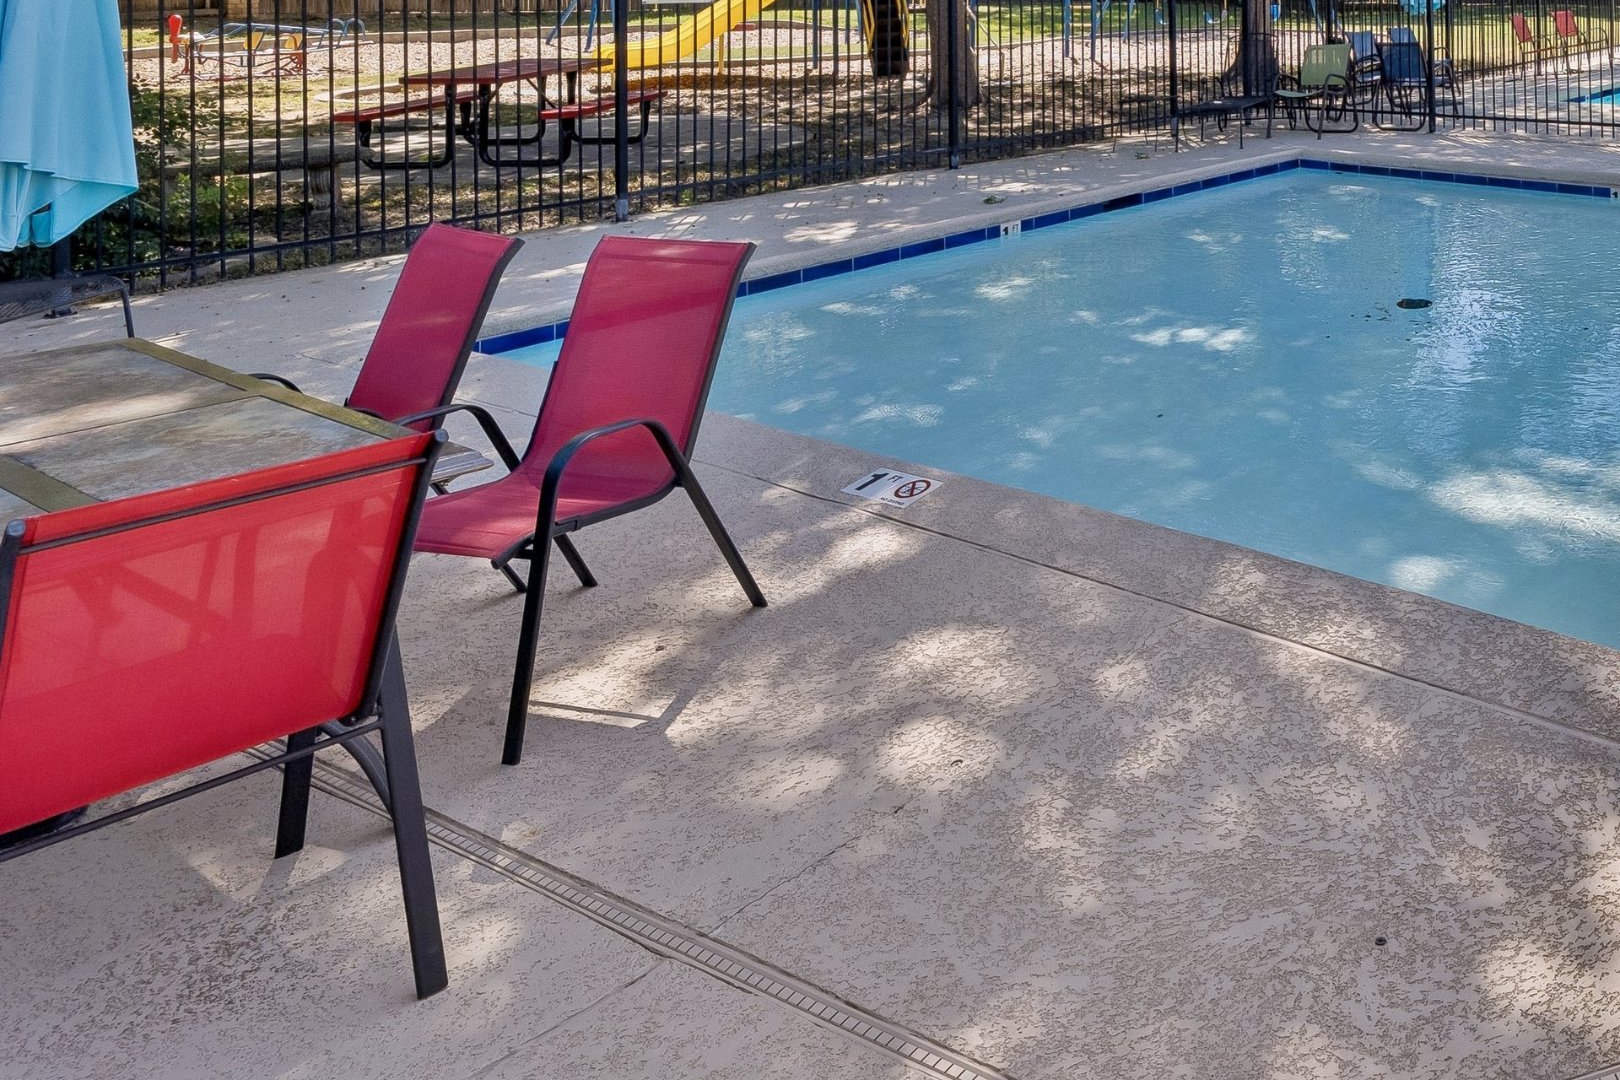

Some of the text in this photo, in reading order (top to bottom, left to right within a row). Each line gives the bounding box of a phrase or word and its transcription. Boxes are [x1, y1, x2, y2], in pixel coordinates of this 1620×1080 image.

[1611, 191, 1619, 199] 1
[1002, 225, 1009, 236] 1
[854, 472, 904, 491] 1 FT
